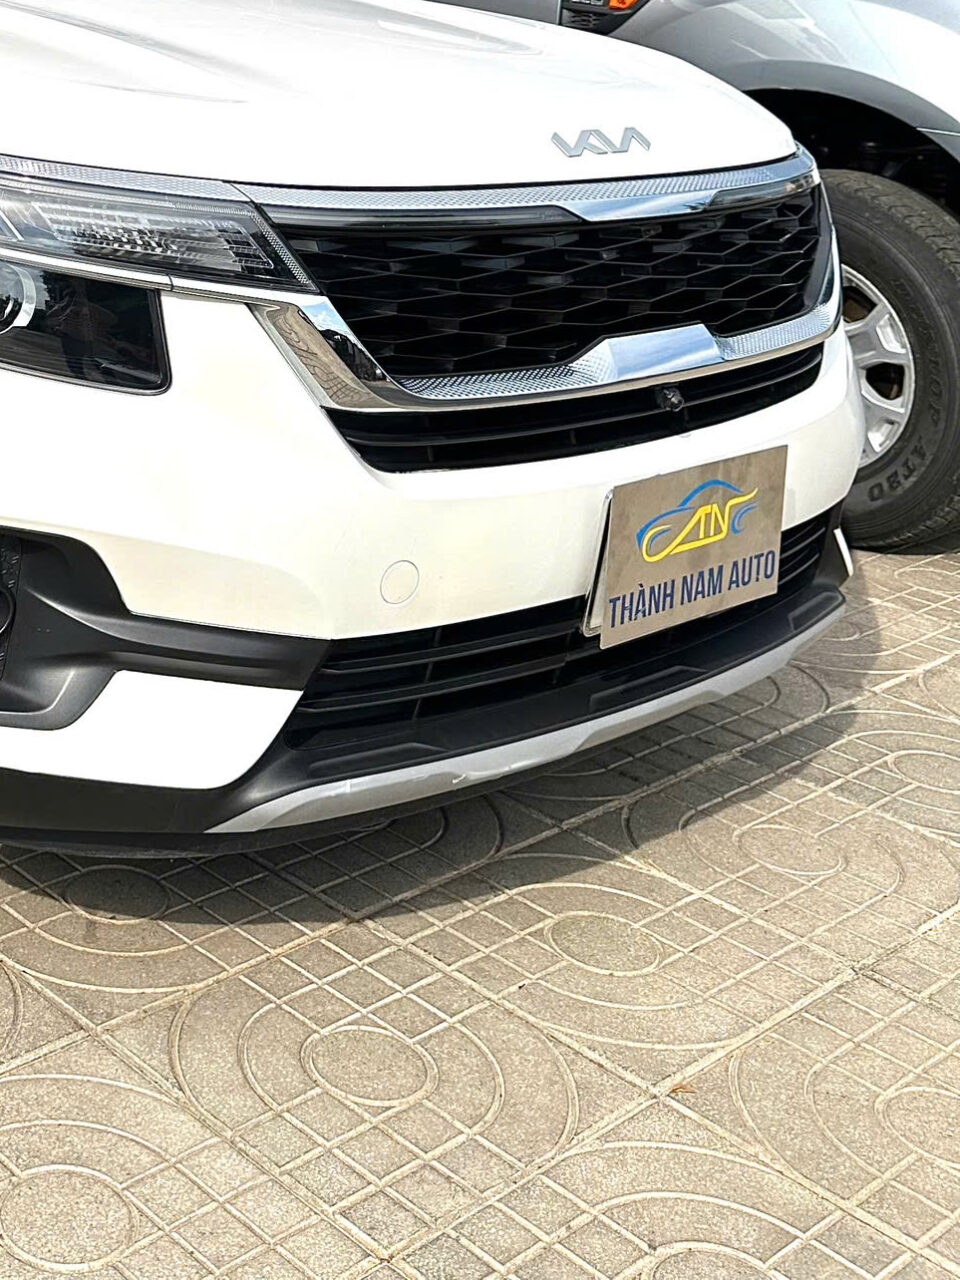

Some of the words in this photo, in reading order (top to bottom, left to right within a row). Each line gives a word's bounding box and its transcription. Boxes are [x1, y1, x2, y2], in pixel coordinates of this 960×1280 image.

[550, 126, 652, 158] KIA
[608, 579, 676, 629] THÀNH
[680, 564, 724, 605] NAM
[727, 549, 777, 591] AUTO
